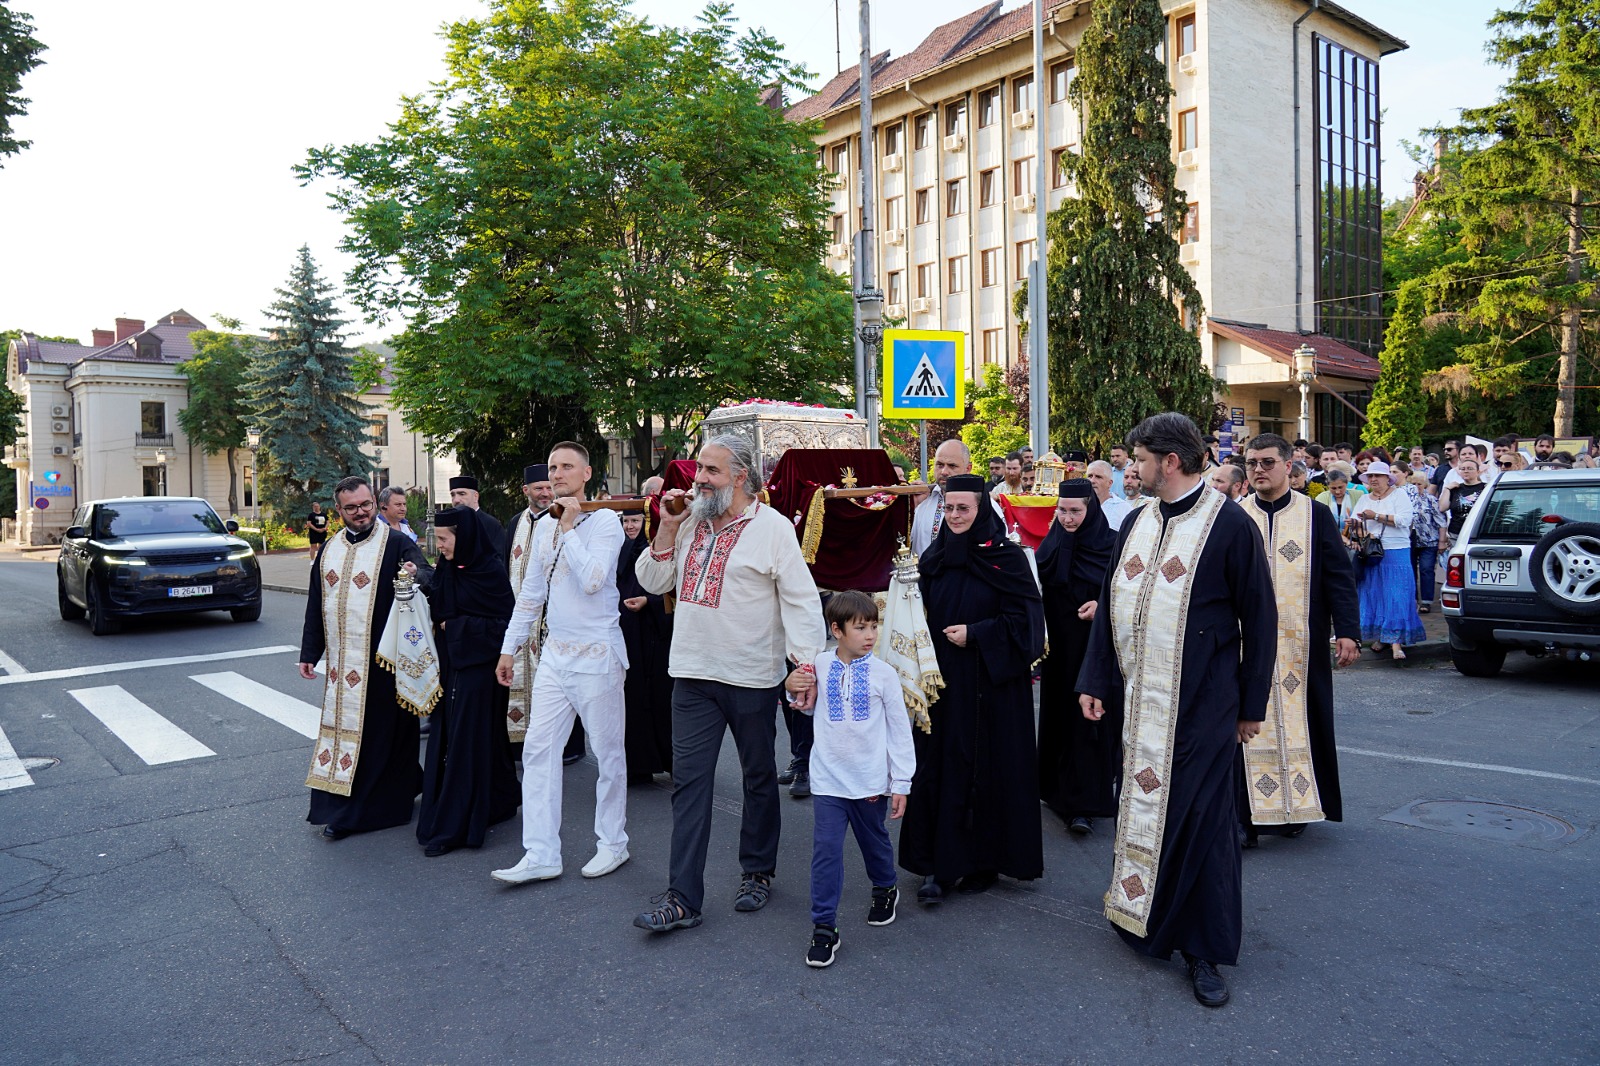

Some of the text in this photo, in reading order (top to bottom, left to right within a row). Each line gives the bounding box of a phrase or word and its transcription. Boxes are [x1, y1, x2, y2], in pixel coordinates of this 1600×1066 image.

[1477, 560, 1512, 572] NT 99
[1480, 572, 1508, 584] PVP
[182, 587, 195, 595] 264
[197, 586, 211, 594] TWT
